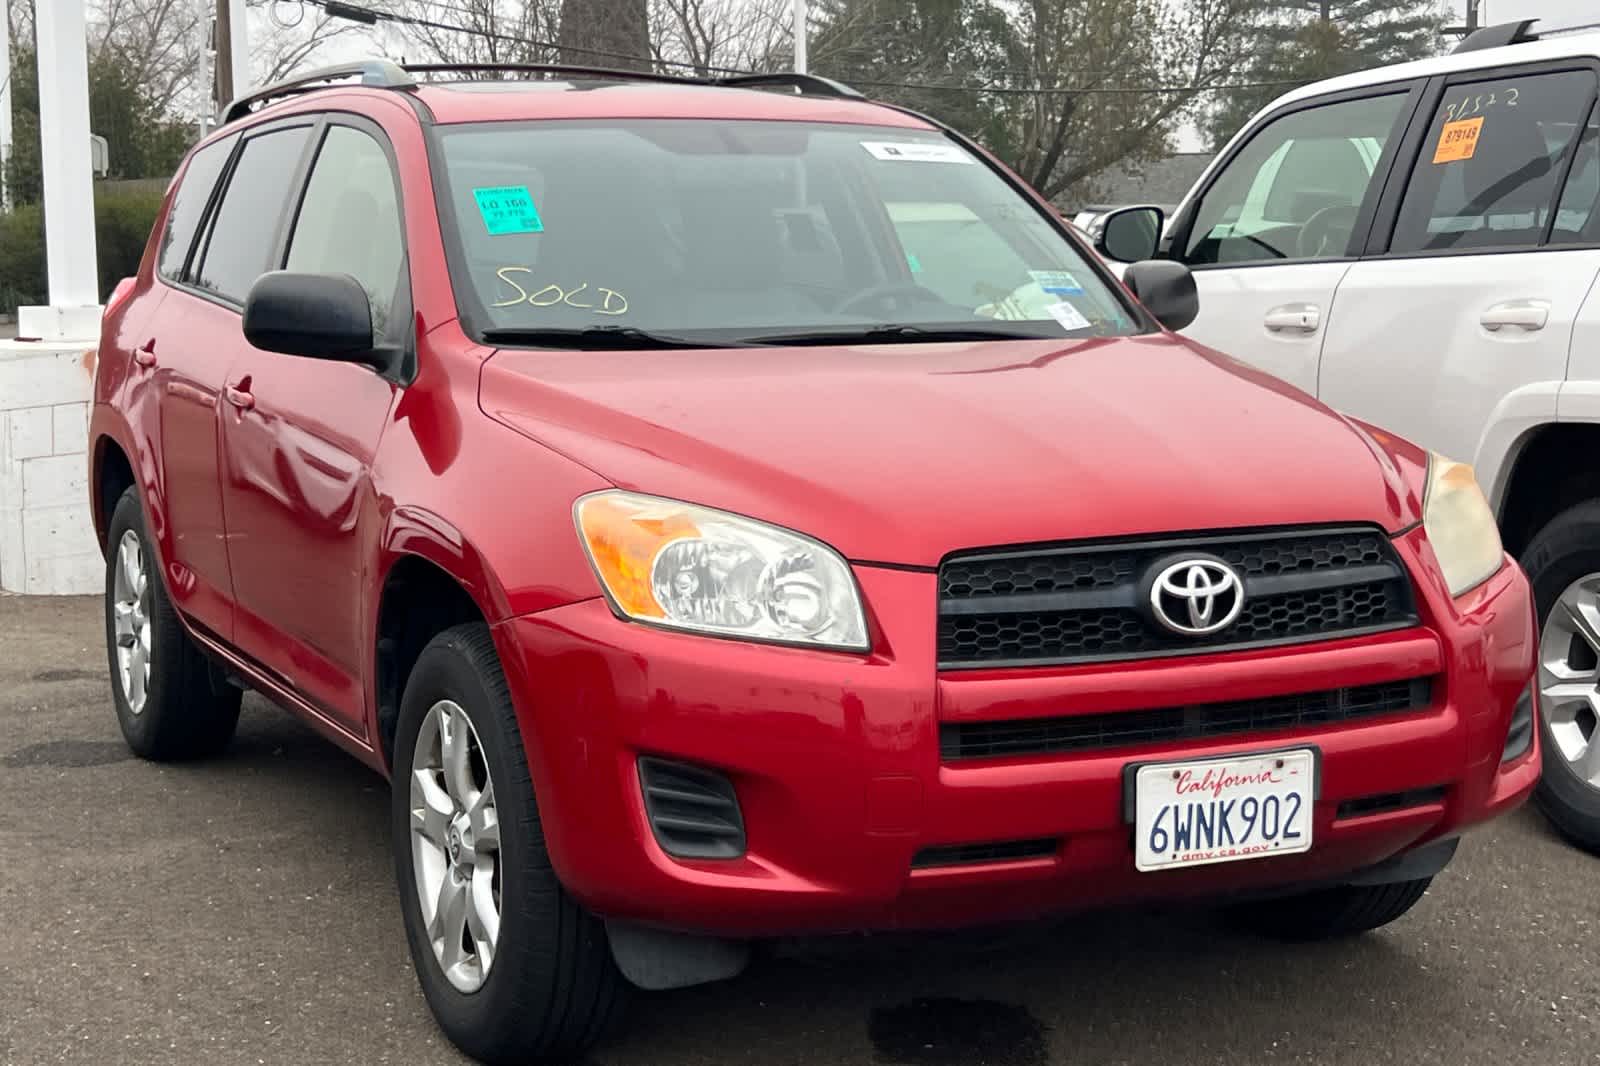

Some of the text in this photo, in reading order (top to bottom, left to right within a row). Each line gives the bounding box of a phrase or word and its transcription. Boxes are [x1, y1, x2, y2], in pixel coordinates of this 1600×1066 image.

[490, 266, 628, 315] SOLD
[1176, 768, 1281, 798] California
[1149, 791, 1302, 854] 6WNK902
[1181, 844, 1270, 862] dmv.ca.gov
